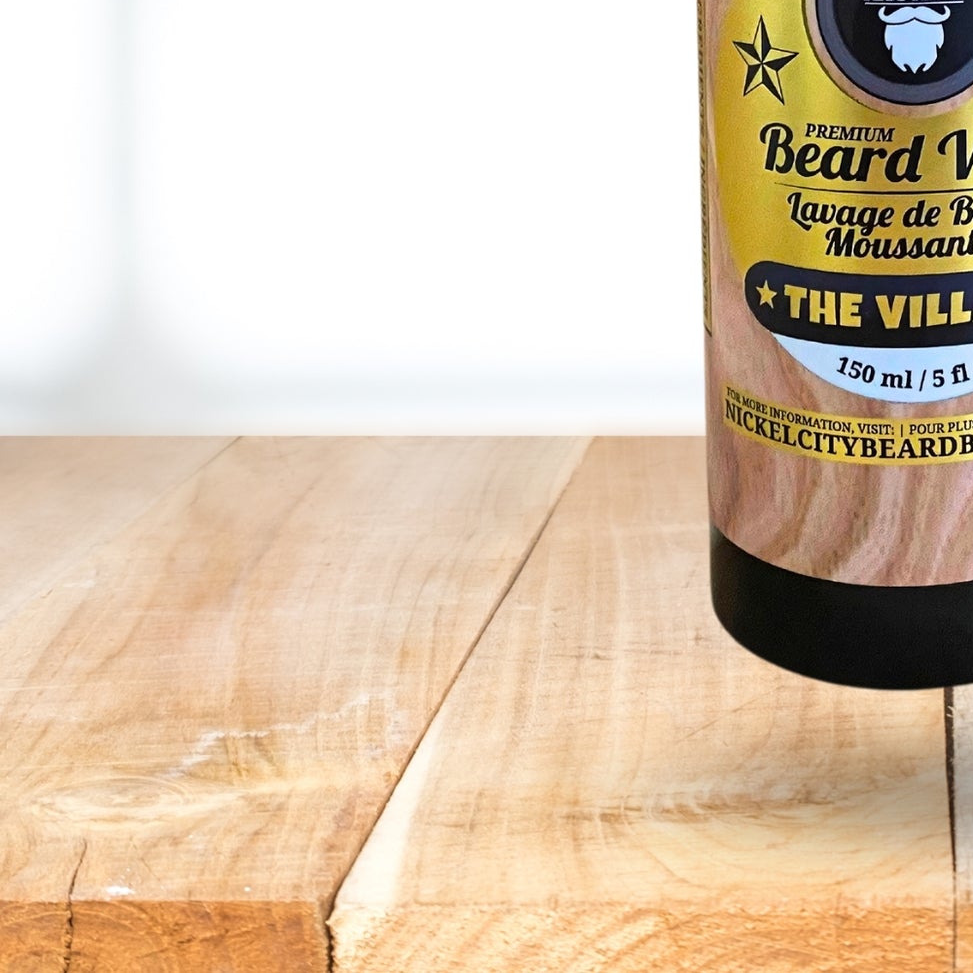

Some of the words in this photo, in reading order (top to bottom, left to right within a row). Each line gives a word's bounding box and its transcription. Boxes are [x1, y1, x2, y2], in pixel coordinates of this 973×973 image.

[760, 122, 926, 183] Beard
[805, 123, 895, 142] PREMIUM
[787, 192, 894, 236] Lavage
[902, 200, 941, 227] de
[784, 284, 863, 327] THE
[836, 356, 875, 383] 150
[880, 369, 913, 389] ml
[932, 369, 945, 388] 5
[951, 363, 970, 385] fl
[726, 386, 741, 404] FOR
[742, 398, 768, 415] MORE
[769, 406, 855, 435] INFORMATION,
[857, 423, 895, 435] VISIT:
[909, 423, 945, 435] POUR
